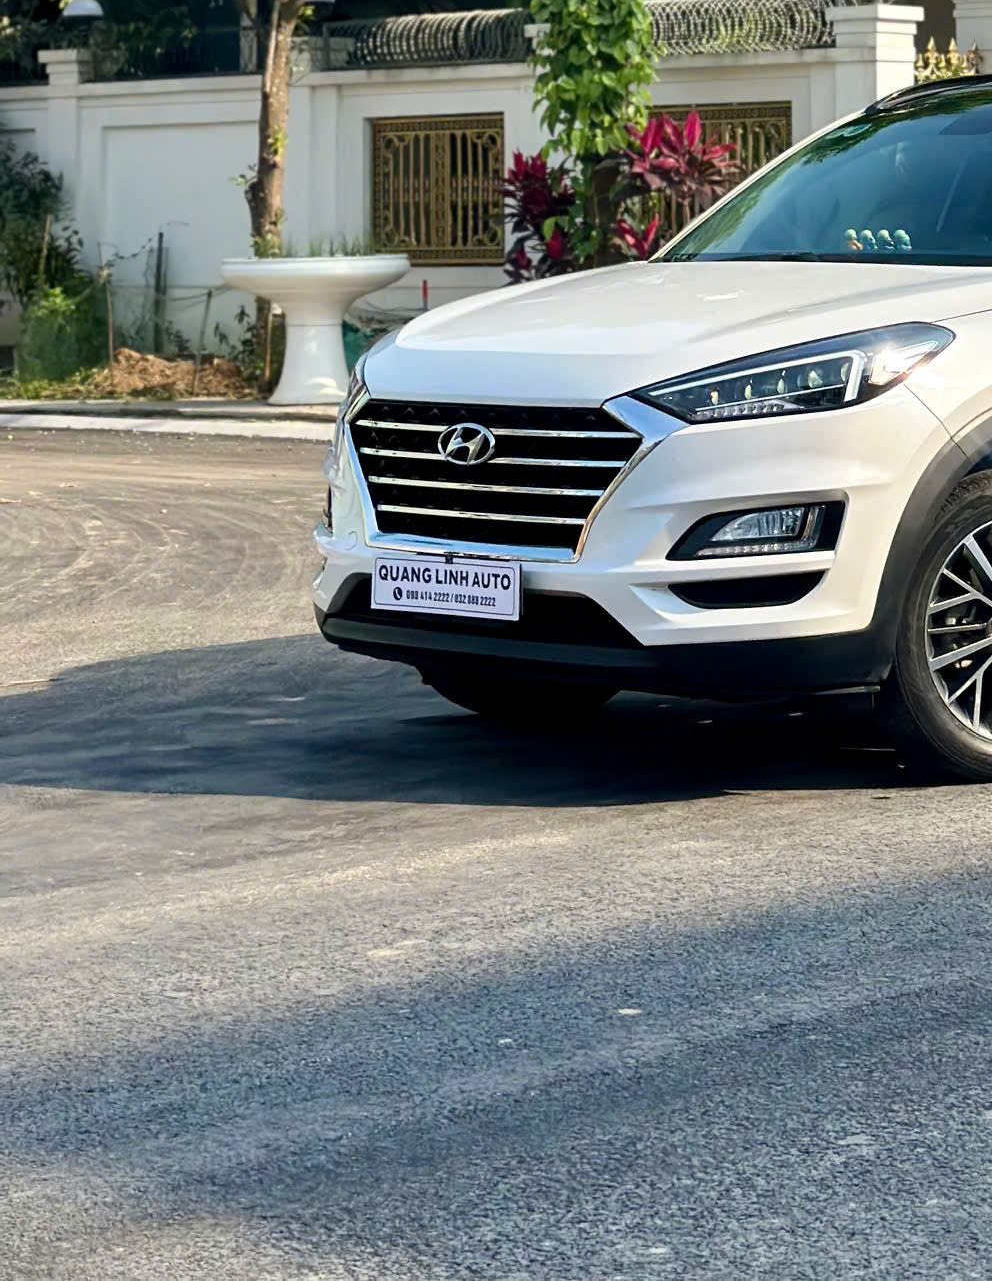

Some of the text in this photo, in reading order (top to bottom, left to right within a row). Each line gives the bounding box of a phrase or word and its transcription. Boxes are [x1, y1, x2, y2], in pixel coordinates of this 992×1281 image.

[378, 564, 511, 591] QUANG LINH AUTO
[420, 591, 432, 601] 414
[433, 591, 449, 603] 2222
[480, 597, 496, 607] 2222
